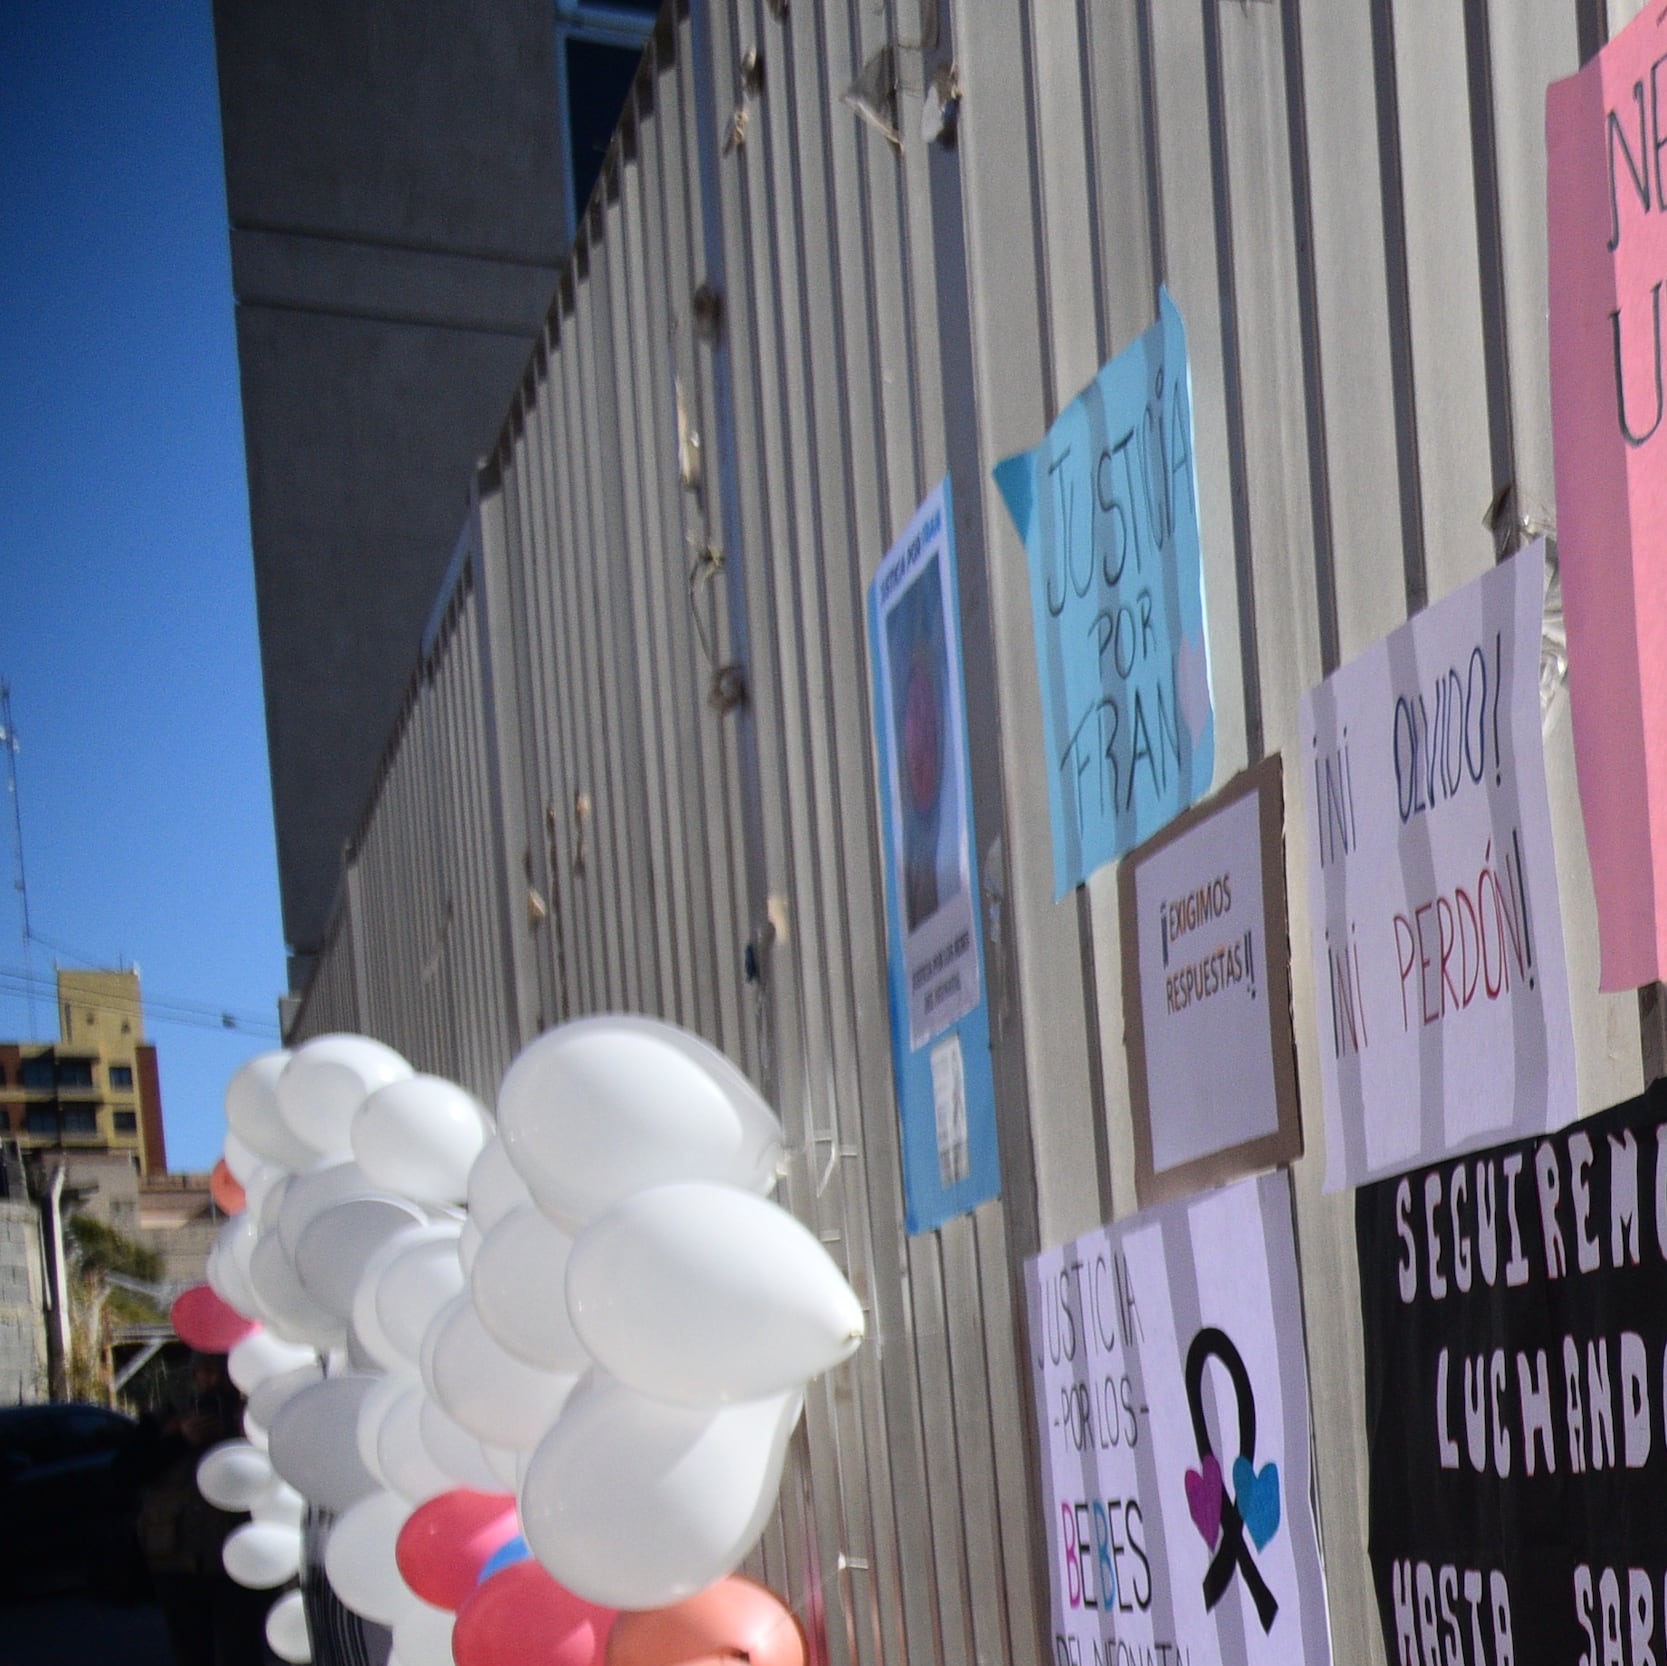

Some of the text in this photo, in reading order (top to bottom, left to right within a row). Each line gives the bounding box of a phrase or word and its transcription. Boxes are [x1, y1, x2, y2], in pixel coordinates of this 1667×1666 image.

[1087, 586, 1158, 681] POR
[1060, 654, 1182, 841] FRAN
[1393, 632, 1503, 824] OLVIDO!
[1393, 827, 1536, 1033] PERDÓN!
[1037, 1250, 1146, 1370] JUSTICIA
[1061, 1498, 1153, 1613] BEBES
